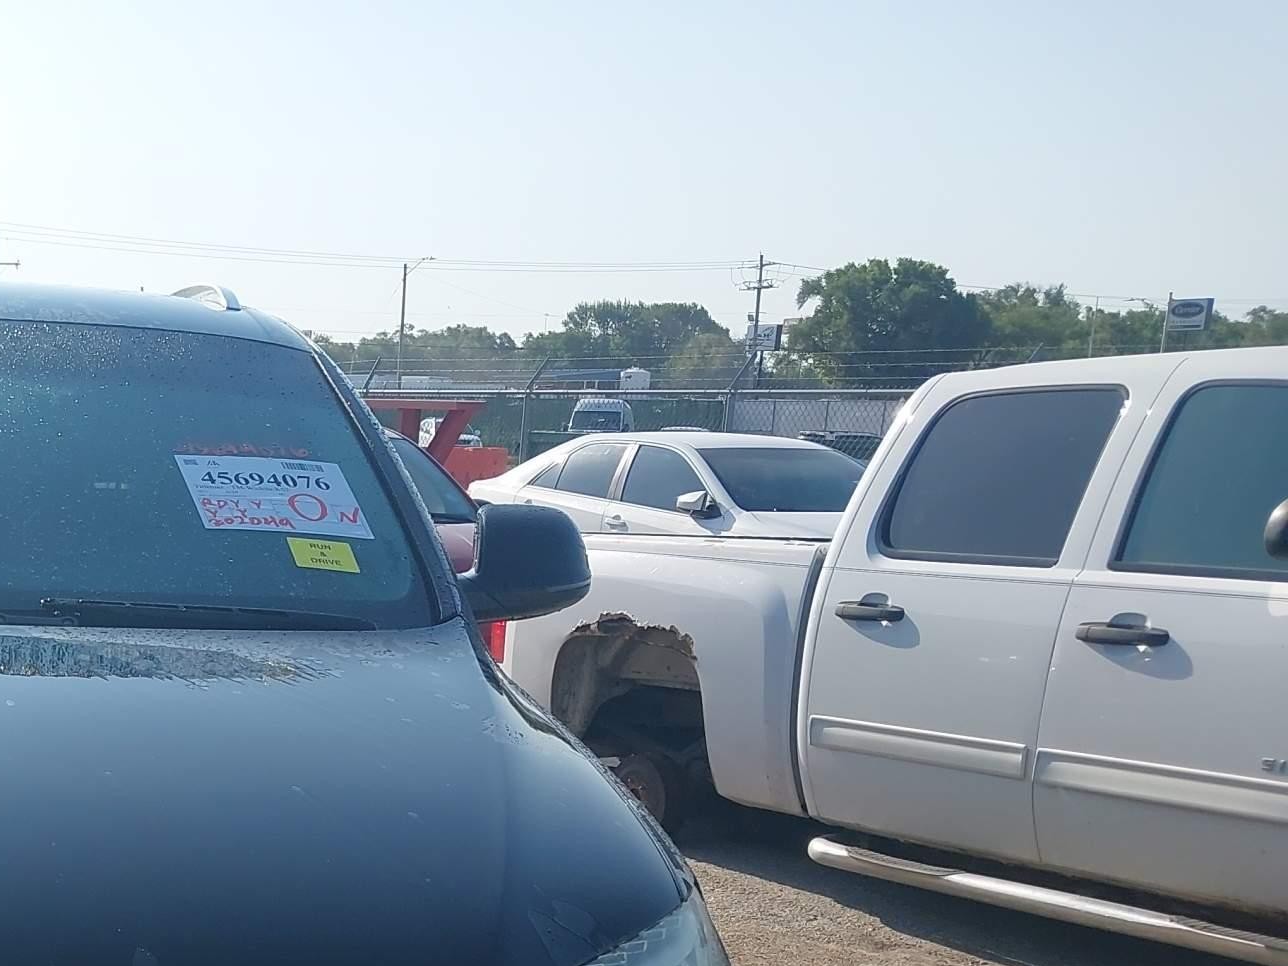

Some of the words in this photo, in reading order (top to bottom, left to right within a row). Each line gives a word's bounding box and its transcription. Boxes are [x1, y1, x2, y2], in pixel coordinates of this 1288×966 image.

[201, 471, 331, 491] 45694076
[309, 542, 332, 551] RUN
[310, 557, 343, 566] DRIVE
